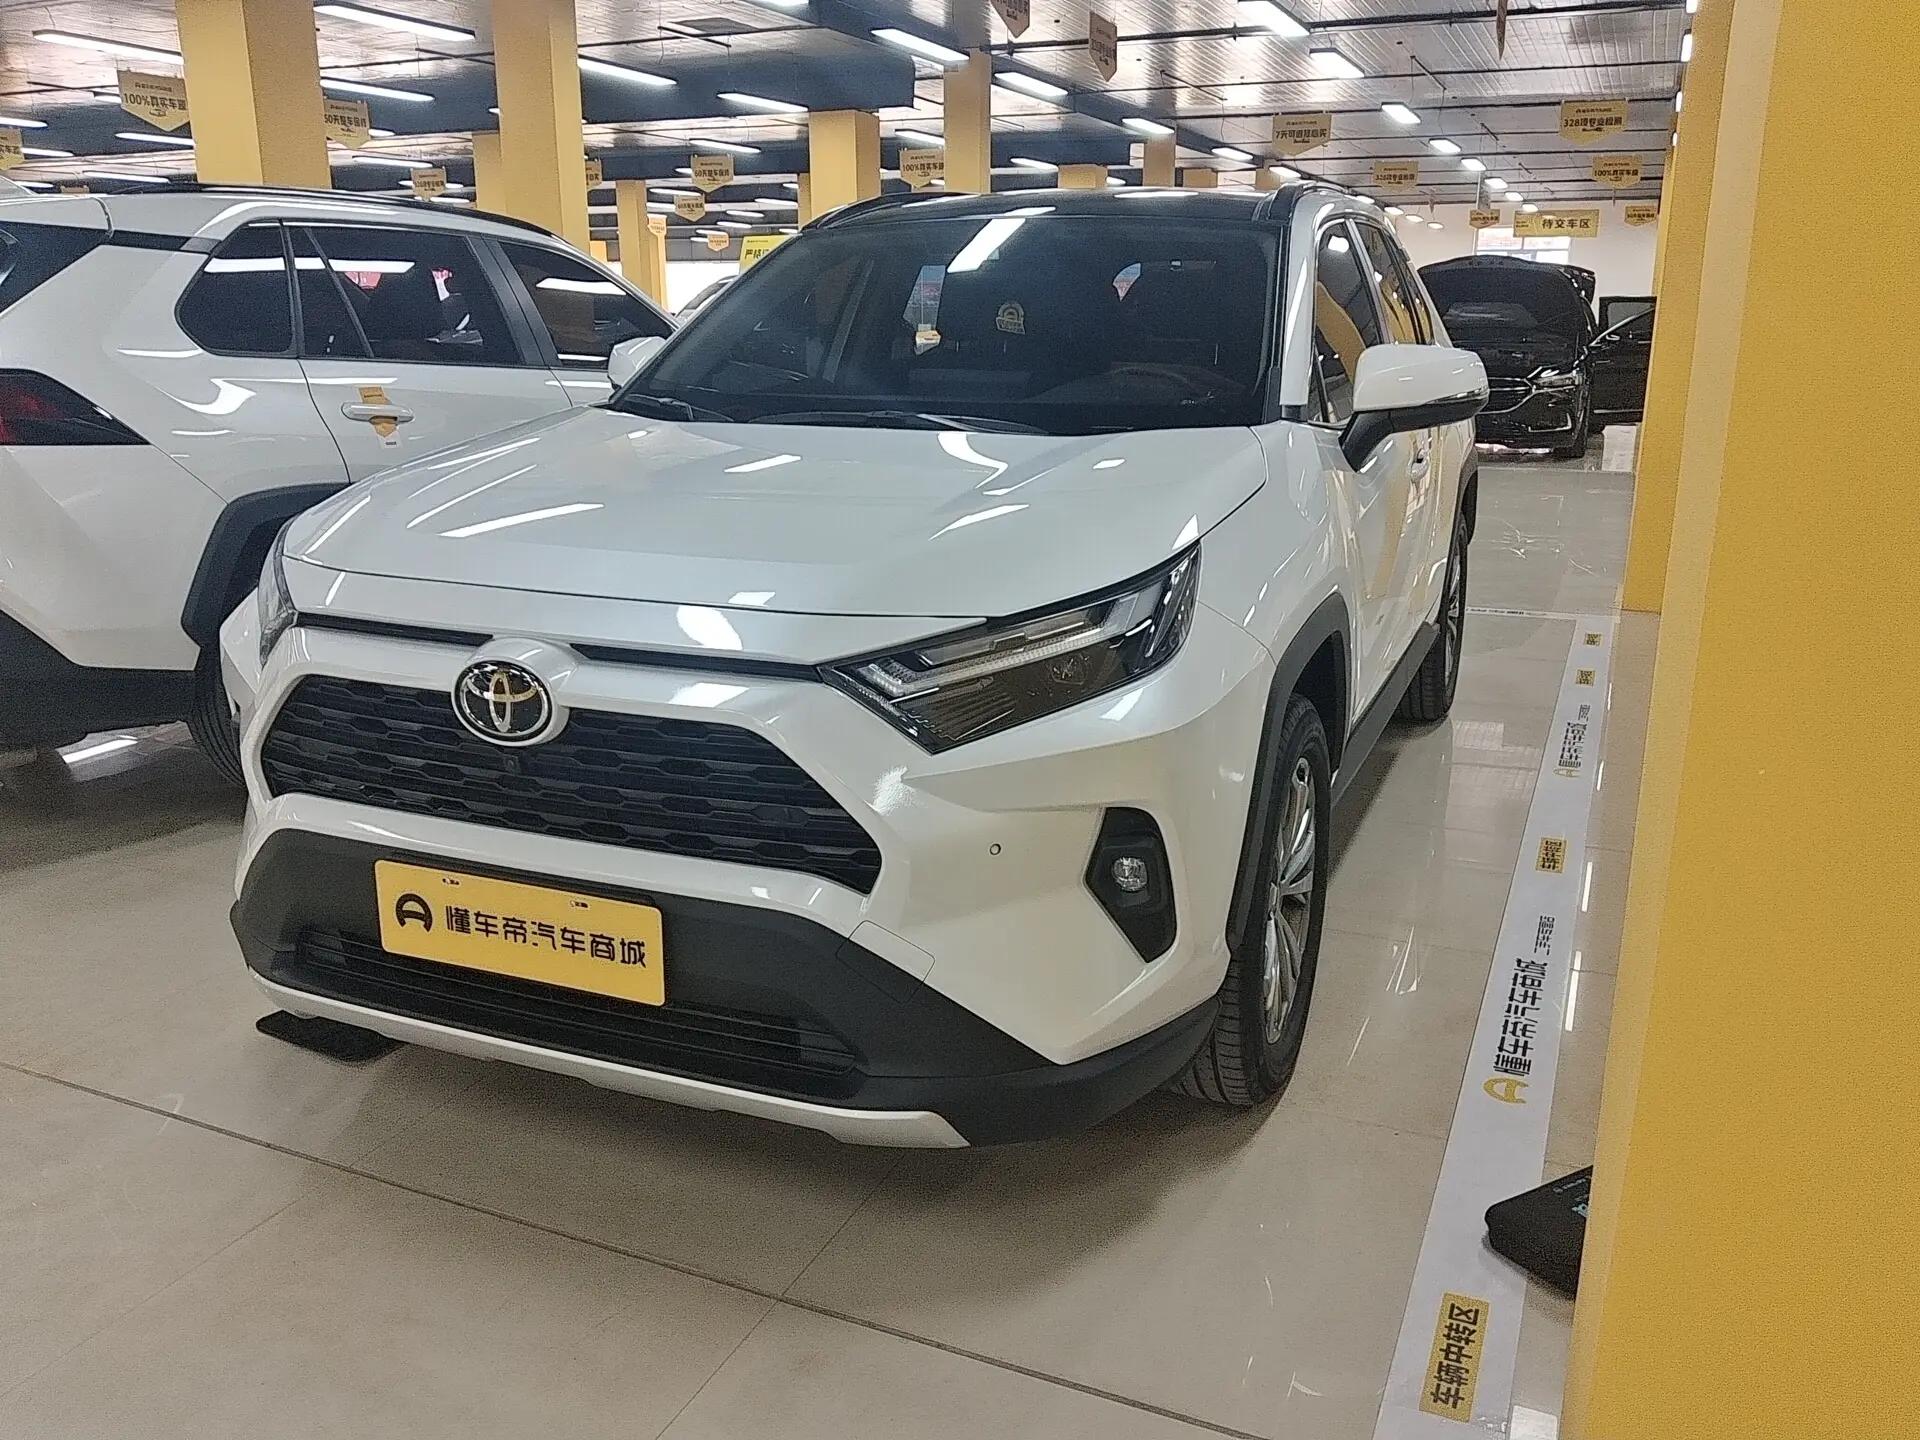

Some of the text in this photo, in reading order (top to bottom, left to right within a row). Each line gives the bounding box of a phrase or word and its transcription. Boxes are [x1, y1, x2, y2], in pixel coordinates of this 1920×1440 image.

[1542, 218, 1591, 229] 待交车区
[445, 905, 647, 968] 懂车帝汽车商城
[1493, 957, 1548, 1076] 懂车帝汽车商城
[1430, 1302, 1479, 1410] 车辆中转区
